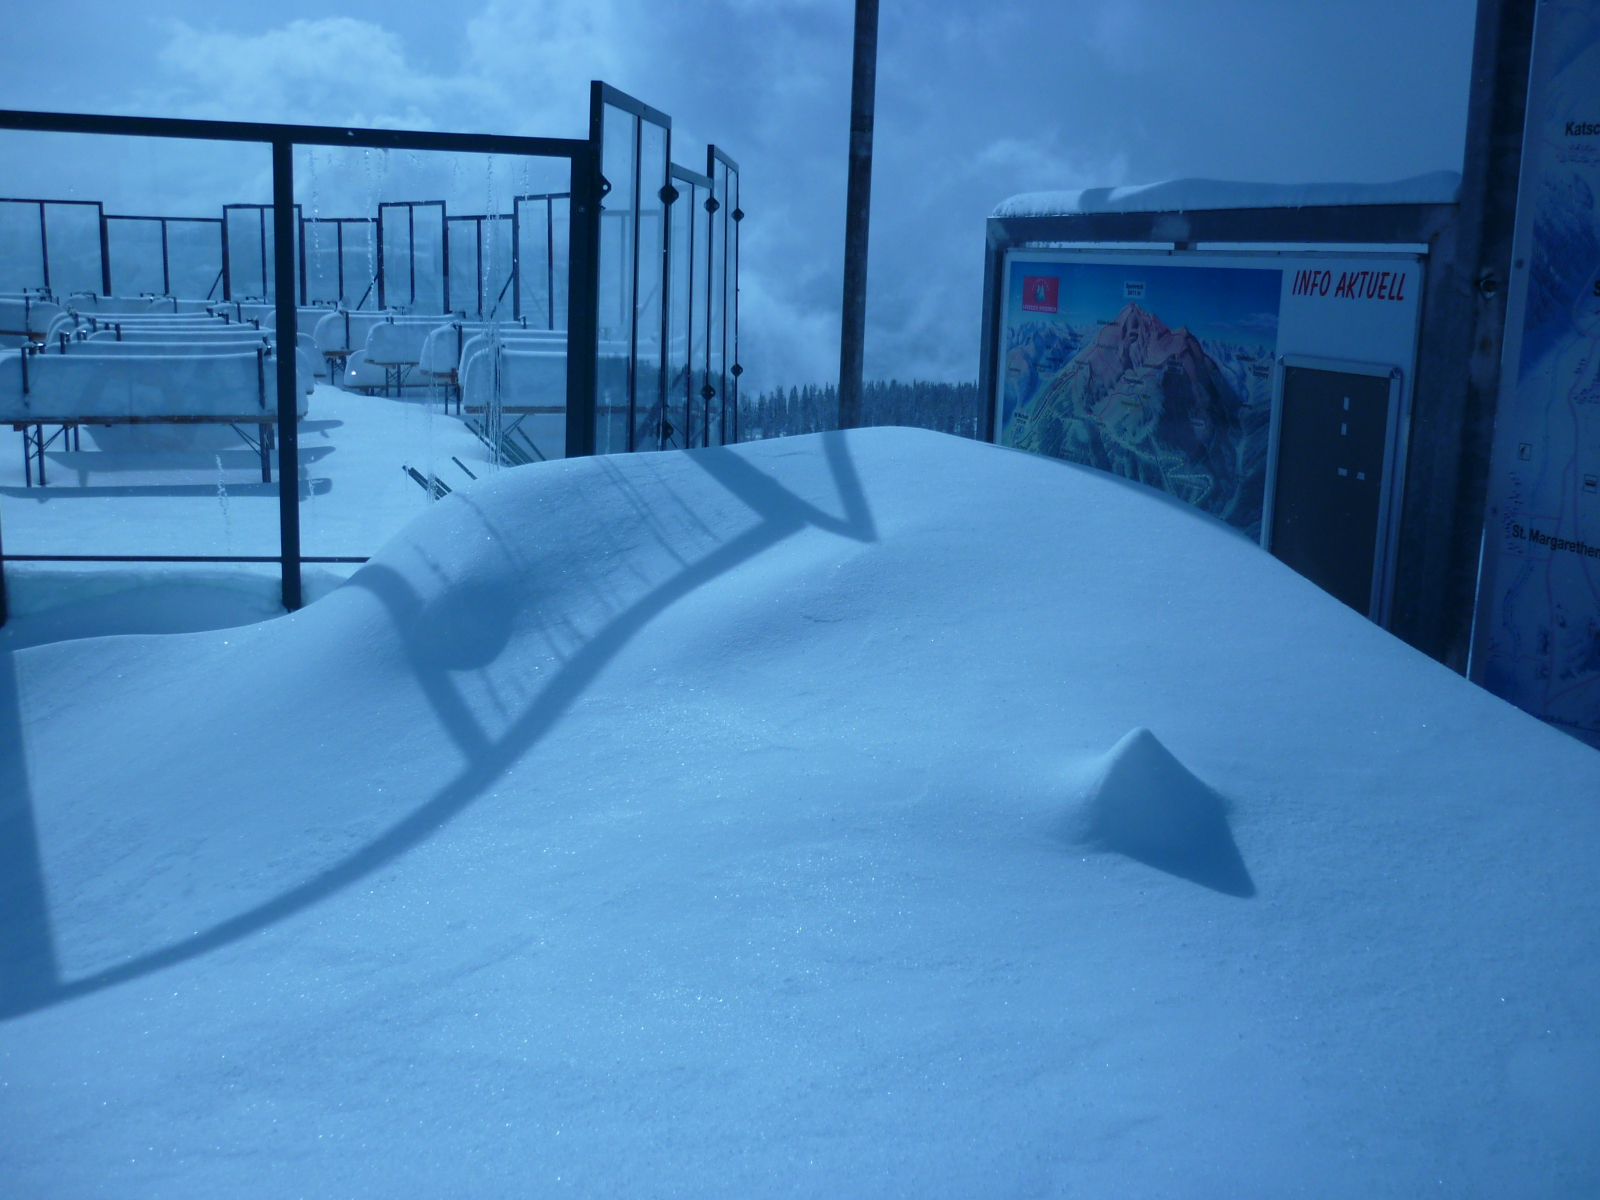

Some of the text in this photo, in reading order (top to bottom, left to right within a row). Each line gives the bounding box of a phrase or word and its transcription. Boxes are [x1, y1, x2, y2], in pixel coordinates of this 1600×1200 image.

[1292, 270, 1406, 301] INFO AKTUELL
[1512, 524, 1600, 560] St. Margarethen
